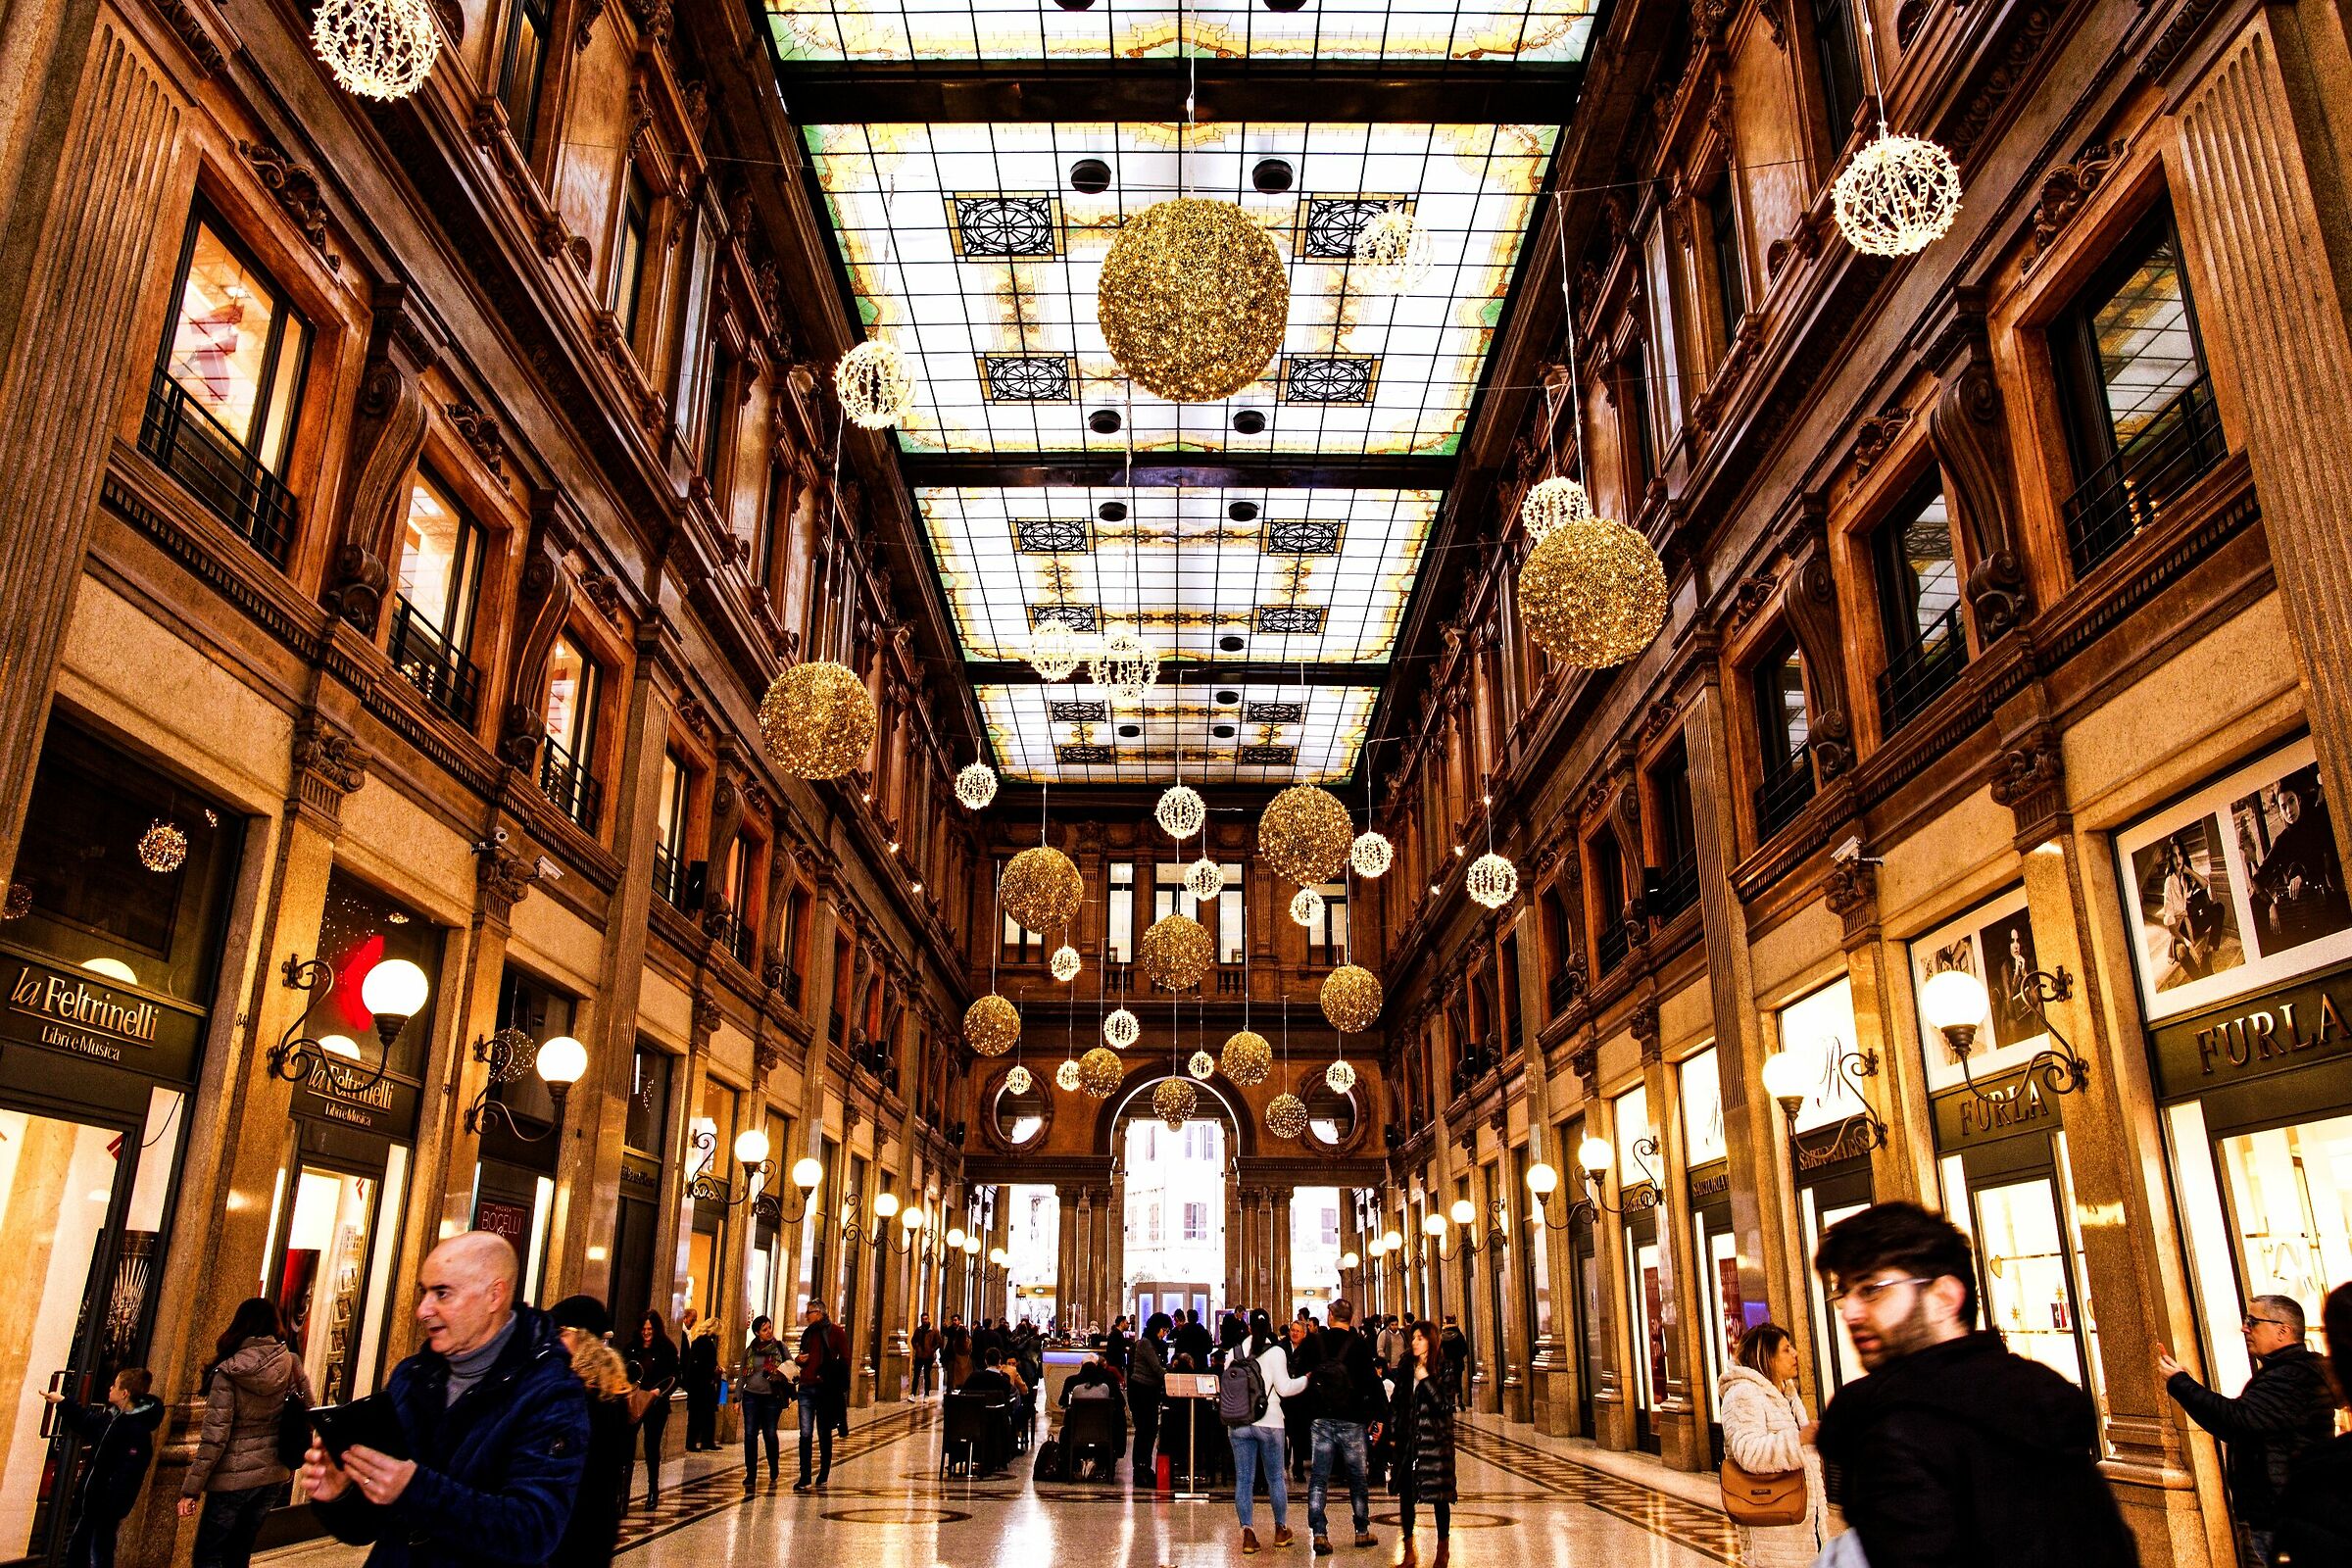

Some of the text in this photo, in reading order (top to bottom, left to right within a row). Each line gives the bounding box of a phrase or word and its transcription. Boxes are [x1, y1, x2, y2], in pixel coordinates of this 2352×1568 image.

[11, 966, 160, 1042] la Feltrinelli
[41, 1025, 121, 1061] Libri e Musica
[2192, 993, 2352, 1076] FURLA
[308, 1058, 326, 1089] la
[346, 1107, 371, 1126] Musica
[1960, 1079, 2049, 1136] FURLA
[481, 1210, 521, 1235] BOCELLI
